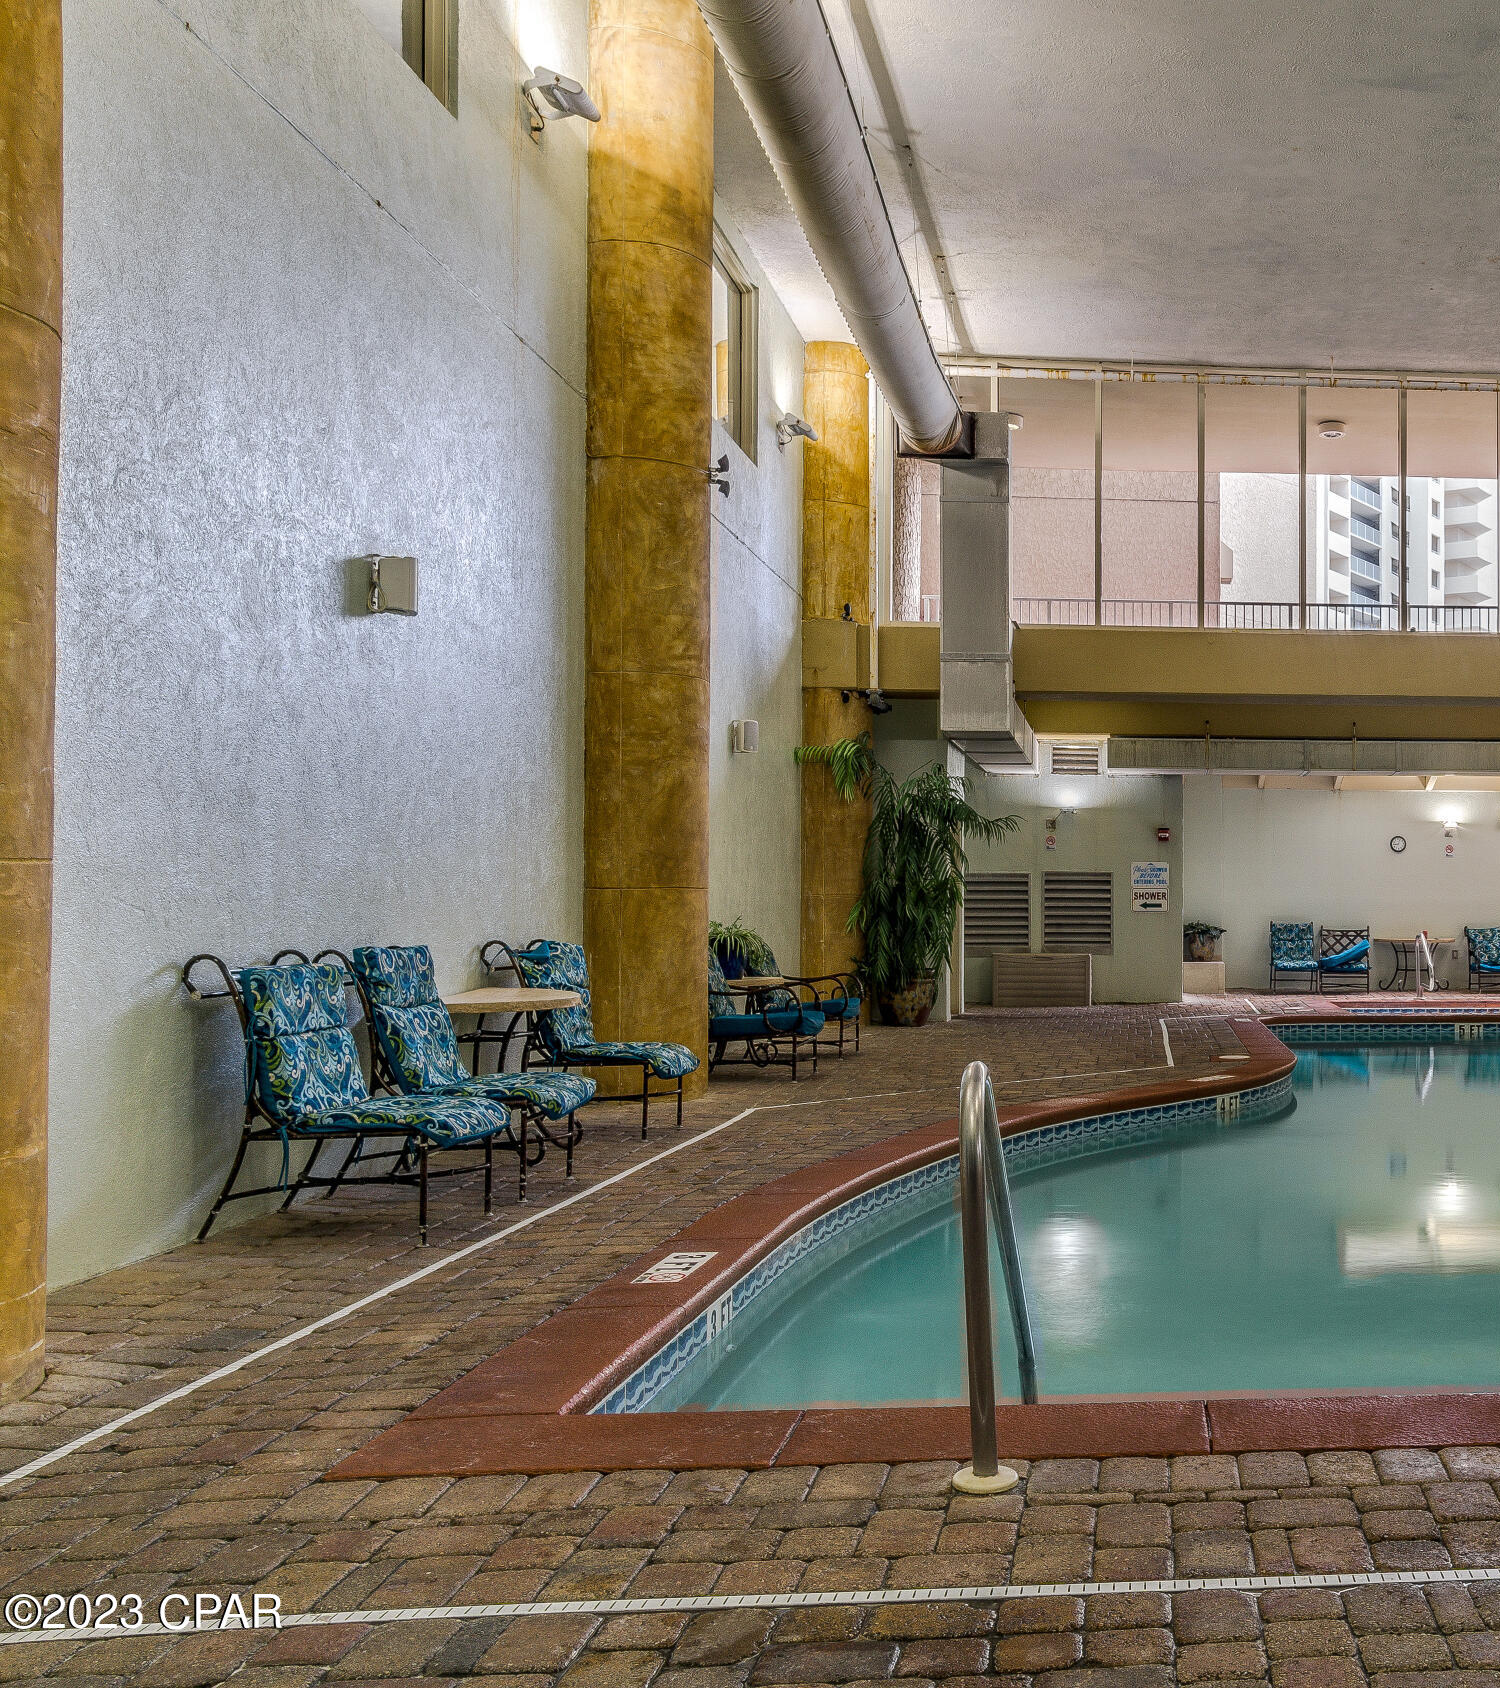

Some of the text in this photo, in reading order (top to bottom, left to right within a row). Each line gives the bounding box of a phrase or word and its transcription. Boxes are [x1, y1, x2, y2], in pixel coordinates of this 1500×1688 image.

[1133, 892, 1167, 900] SHOWER
[1220, 1098, 1225, 1111] 4
[711, 1296, 731, 1338] 3 FT
